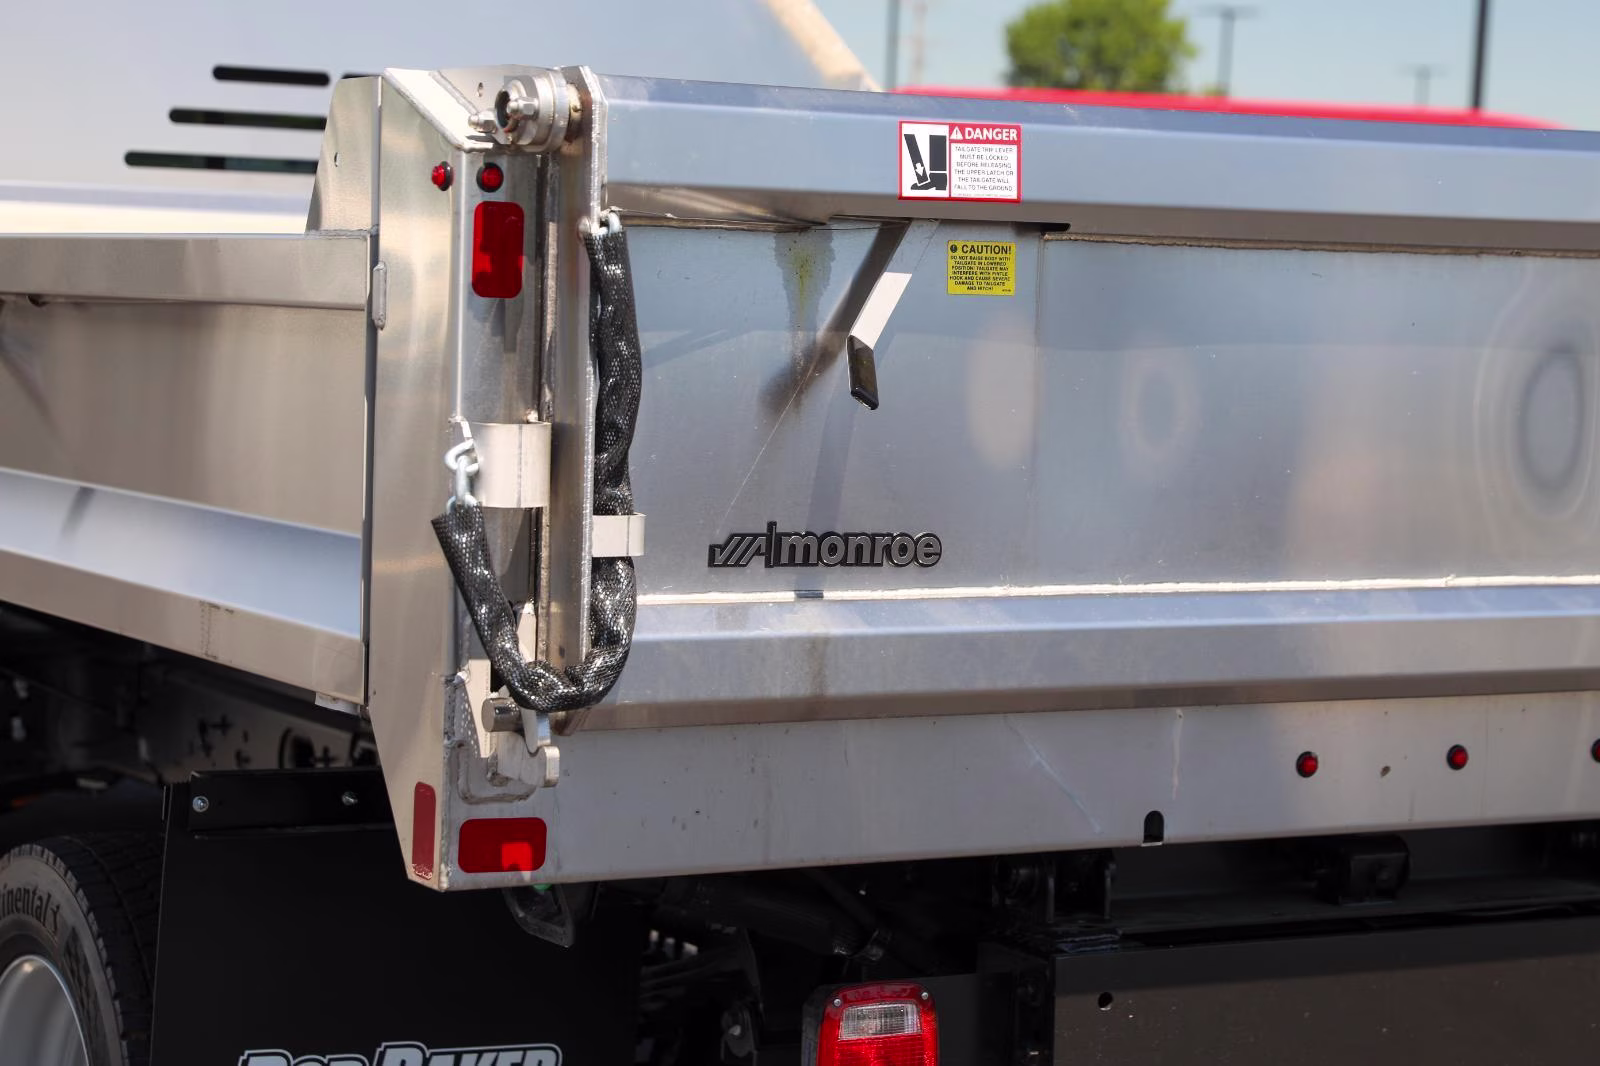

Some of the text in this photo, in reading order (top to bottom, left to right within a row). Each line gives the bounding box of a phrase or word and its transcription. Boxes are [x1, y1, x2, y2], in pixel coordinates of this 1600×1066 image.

[965, 127, 1018, 140] DANGER
[961, 244, 1012, 255] CAUTION!
[777, 531, 942, 567] monroe
